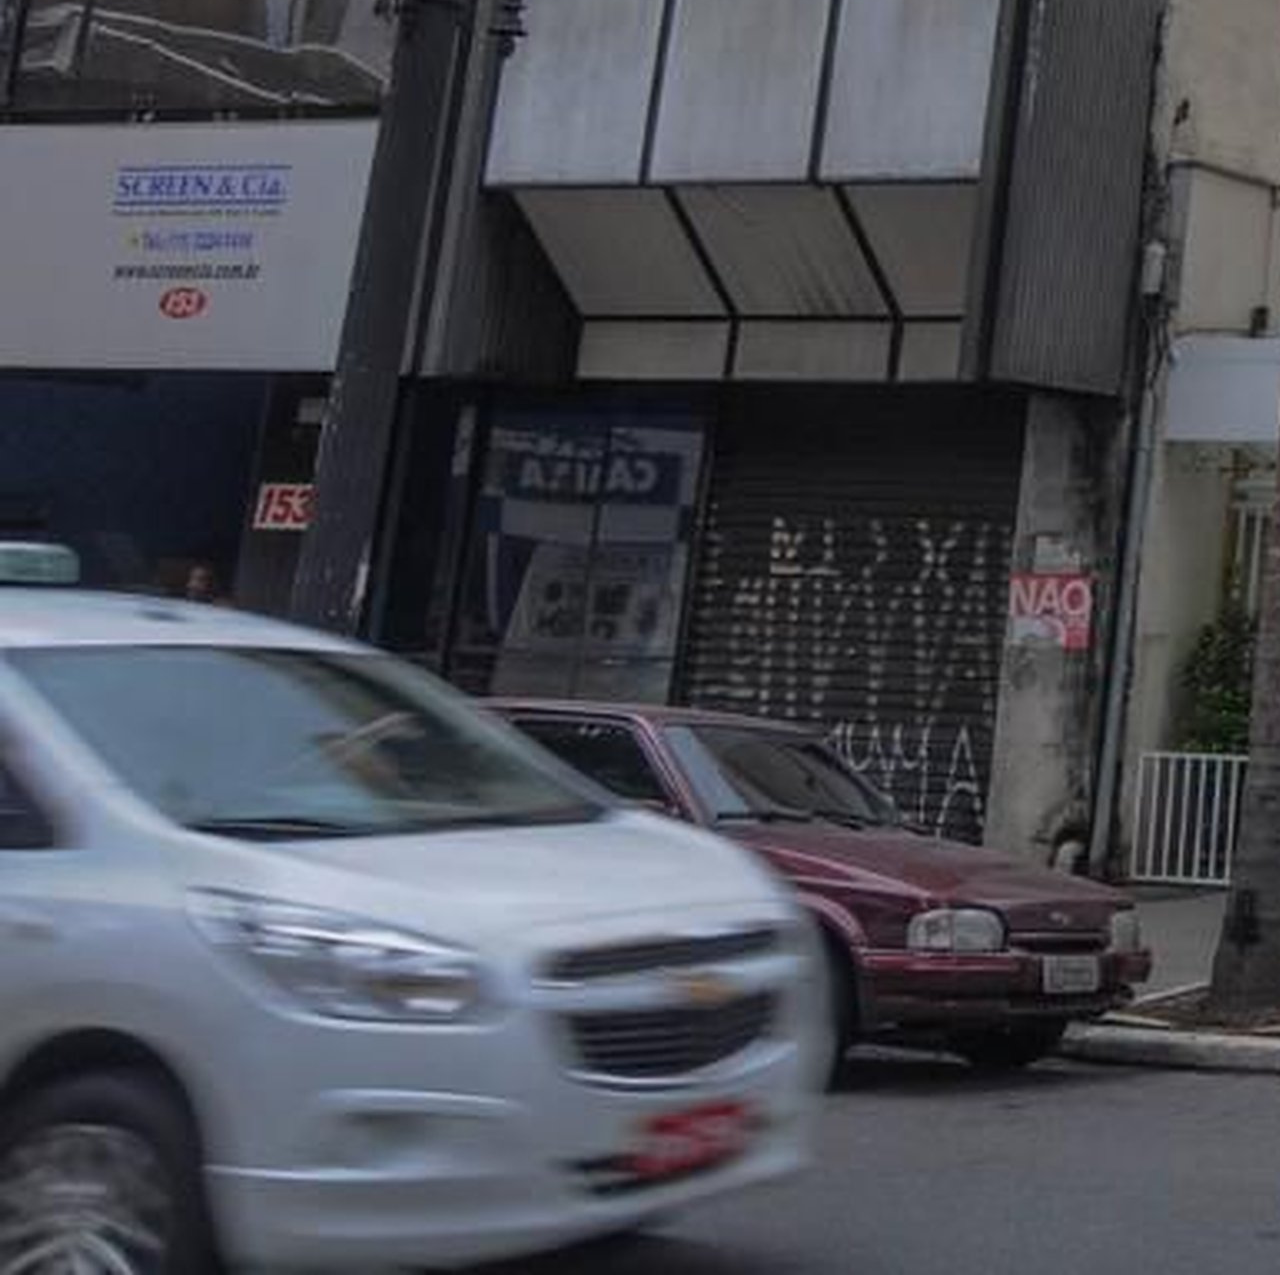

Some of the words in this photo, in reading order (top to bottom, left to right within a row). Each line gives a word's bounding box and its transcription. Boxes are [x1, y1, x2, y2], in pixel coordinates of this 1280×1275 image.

[118, 174, 213, 196] SCREEN
[216, 175, 236, 196] &
[260, 487, 316, 524] 153
